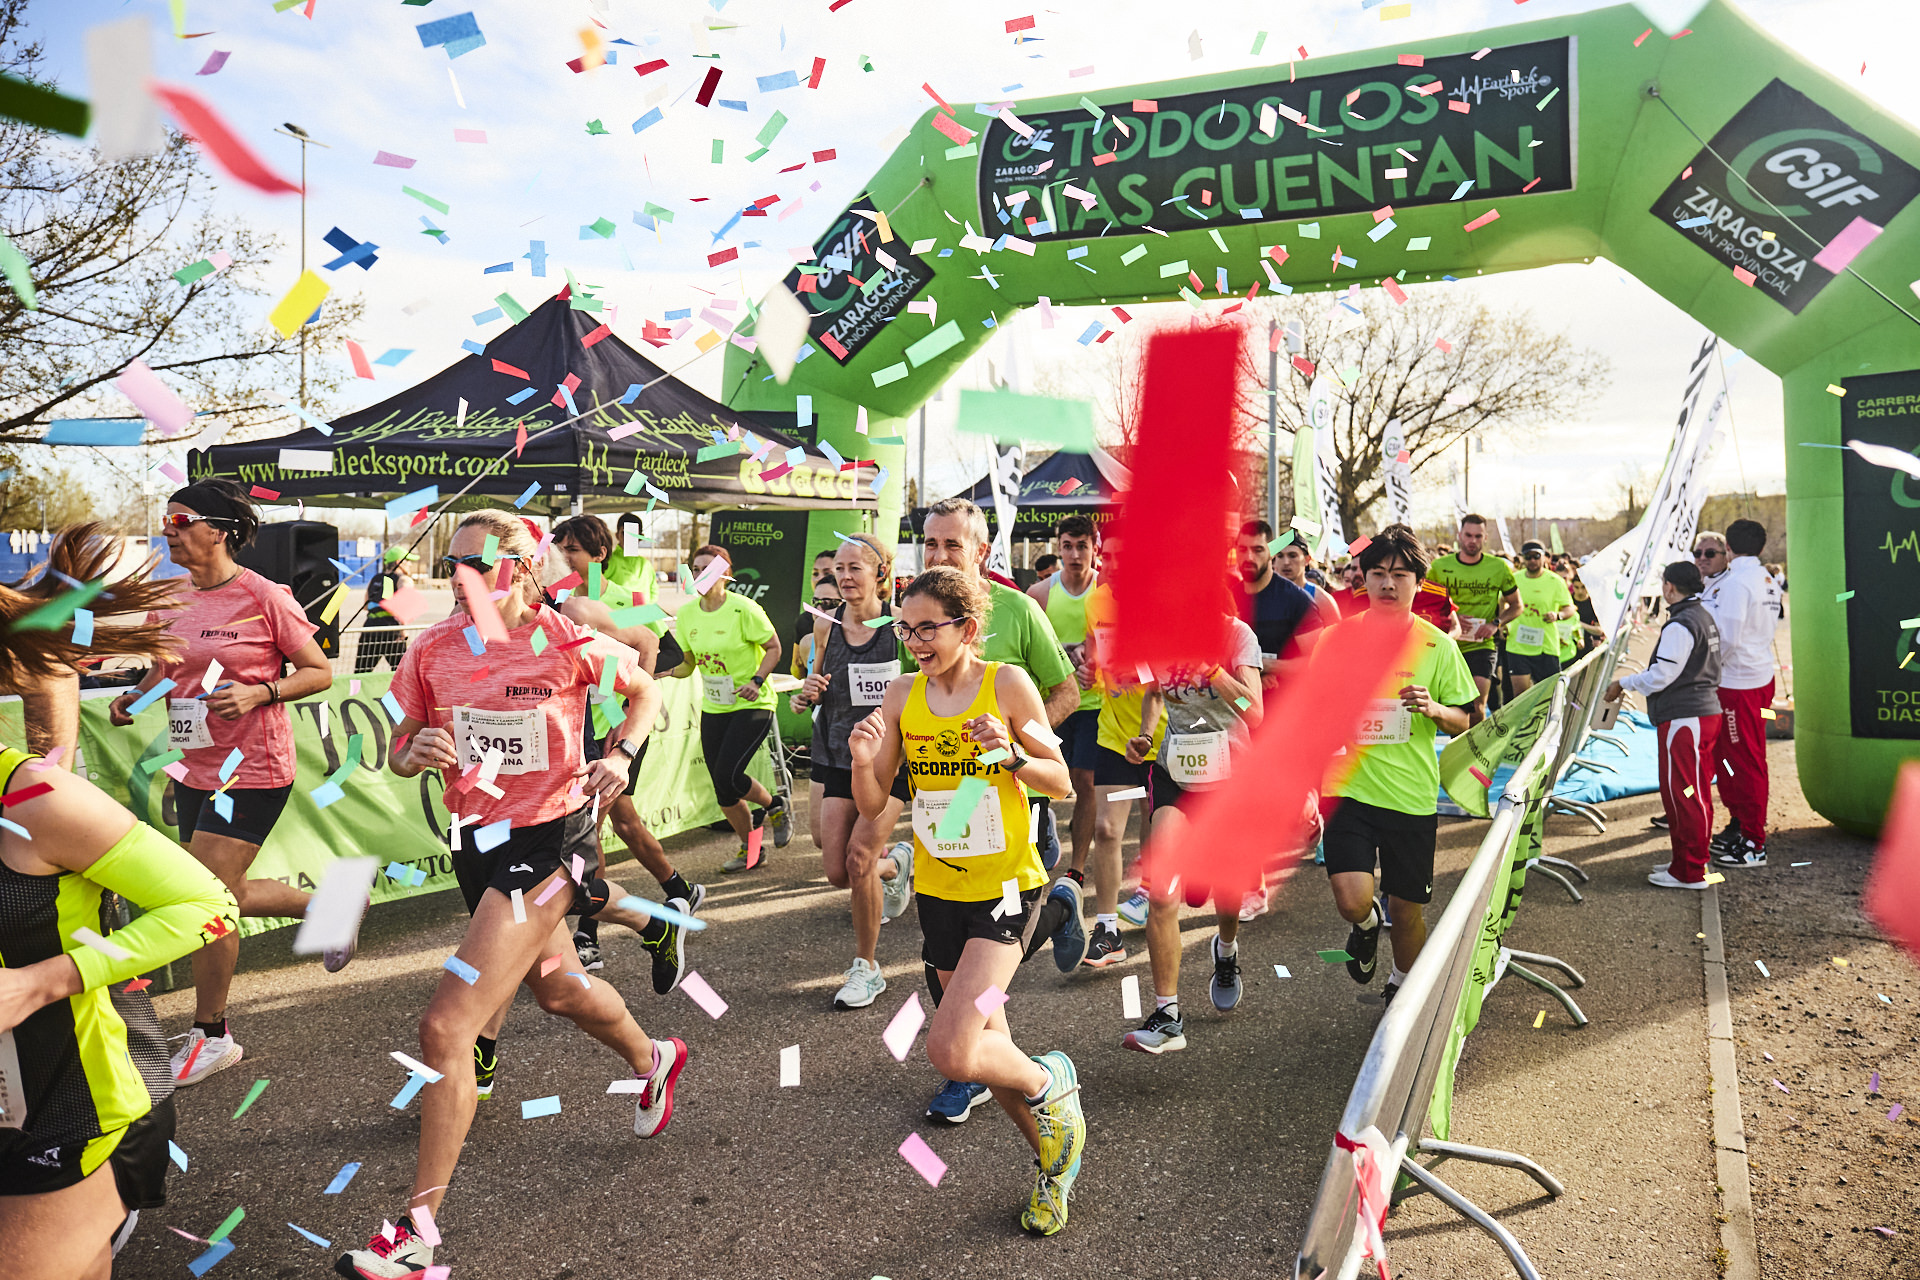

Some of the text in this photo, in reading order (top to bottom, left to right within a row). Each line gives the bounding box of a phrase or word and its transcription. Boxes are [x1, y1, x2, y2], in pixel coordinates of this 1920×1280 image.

[1499, 84, 1537, 101] Sport
[1062, 73, 1440, 167] TODOS LOS
[995, 163, 1047, 177] ZARAGOZ
[1765, 147, 1881, 208] CSIF
[1008, 126, 1540, 236] DÍAS CUENTAN
[1684, 186, 1808, 283] ZARAGOZA
[819, 219, 864, 289] CSIF
[1716, 237, 1795, 297] PROVINCIAL
[828, 264, 910, 342] ZARAGOZA
[842, 273, 921, 350] UNIÓN PROVINCIAL
[1857, 408, 1885, 419] POR
[1888, 406, 1907, 416] LA
[633, 448, 691, 474] Fartleck
[652, 468, 694, 491] Sport
[733, 521, 774, 533] FARTLECK
[733, 535, 773, 546] SPORT
[505, 686, 553, 698] FREDI TEAM
[169, 719, 193, 733] 502
[470, 754, 524, 766] CAINA
[1176, 754, 1208, 768] 708
[937, 842, 970, 851] SOFIA
